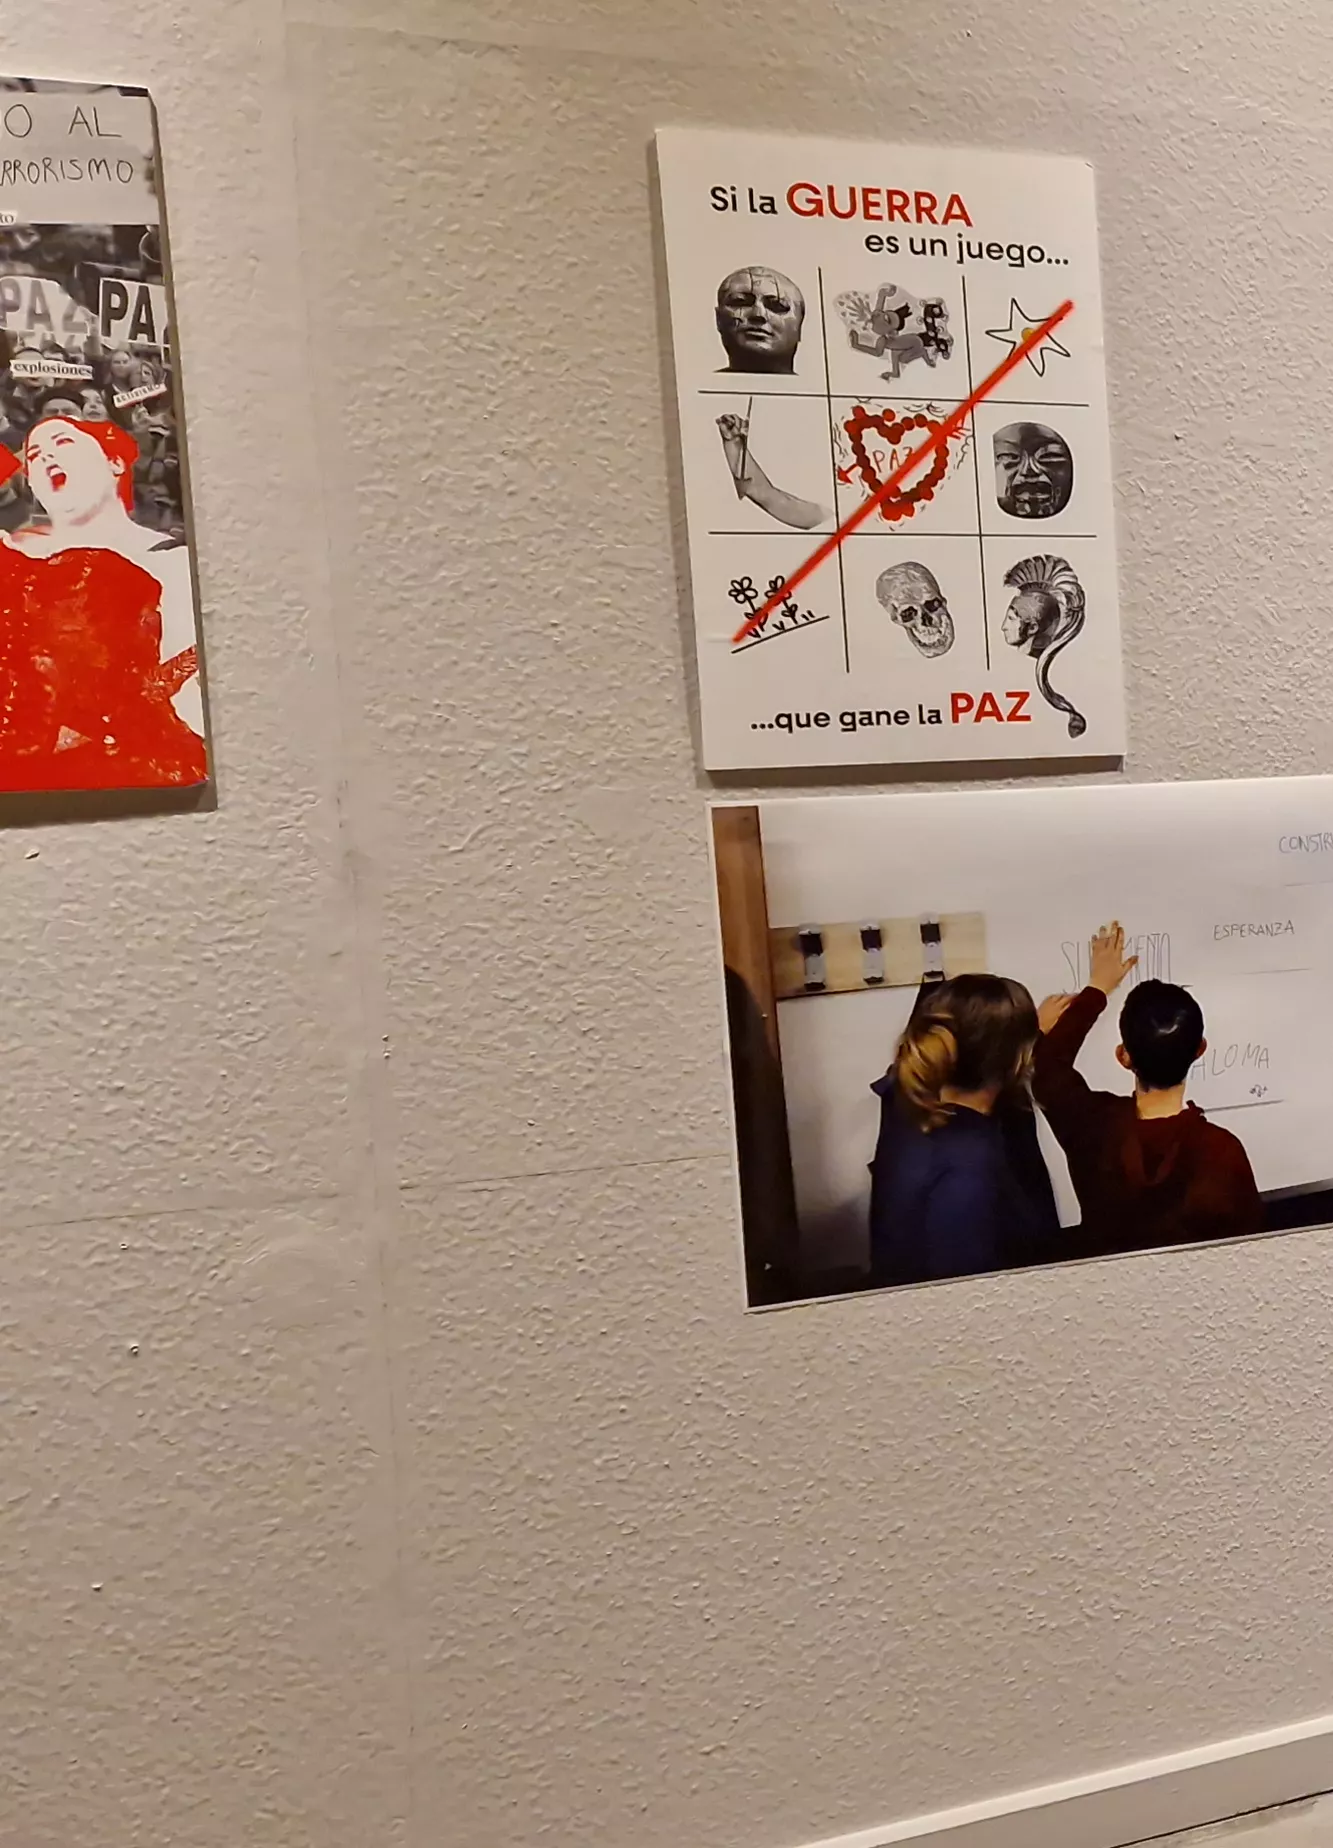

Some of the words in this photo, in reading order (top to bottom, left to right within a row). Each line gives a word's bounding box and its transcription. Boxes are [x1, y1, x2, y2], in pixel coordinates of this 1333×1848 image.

[68, 105, 122, 138] AL
[709, 186, 738, 213] Si
[748, 187, 778, 215] la
[786, 182, 973, 228] GUERRA
[865, 234, 900, 254] es
[908, 237, 948, 257] un
[956, 233, 1069, 268] juego...
[101, 280, 170, 345] PA
[14, 361, 92, 376] explosiones
[751, 711, 830, 733] ...que
[839, 709, 910, 732] gane
[918, 704, 942, 724] la
[951, 691, 1032, 723] PAZ
[1213, 920, 1295, 941] ESPERANZA
